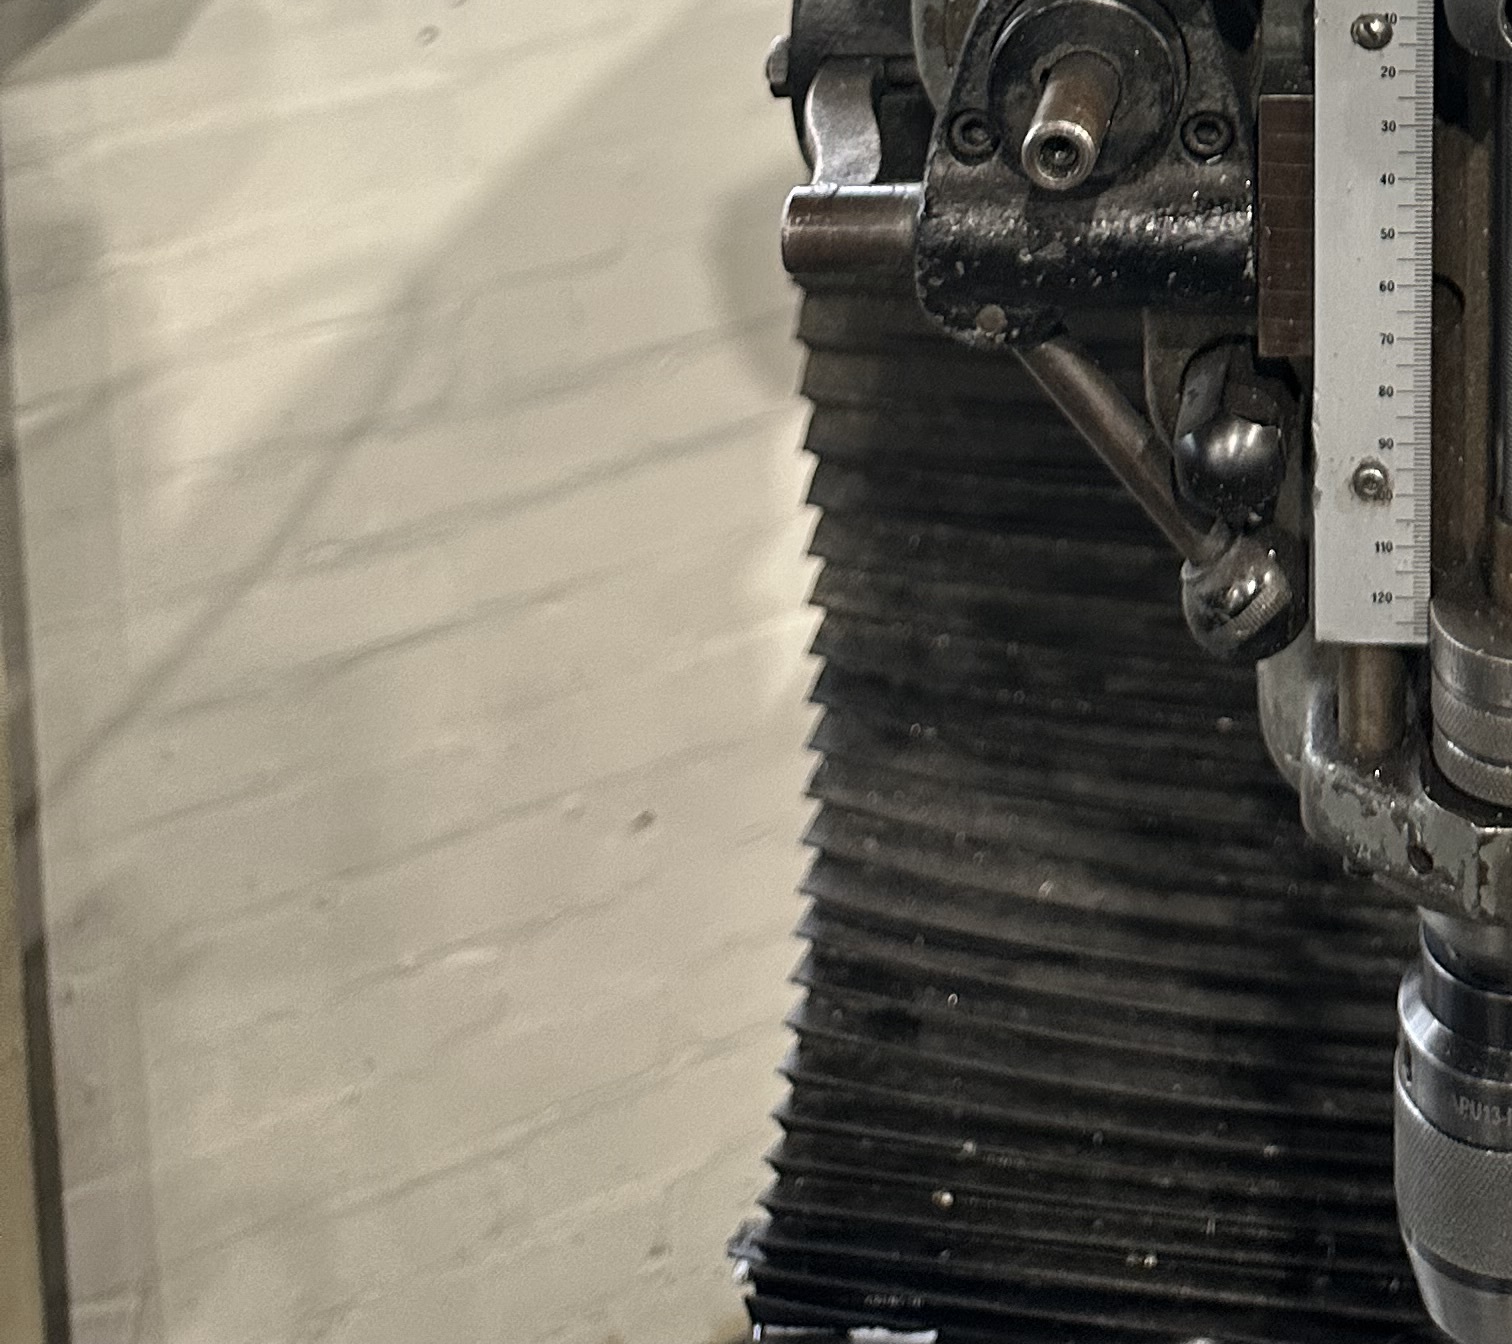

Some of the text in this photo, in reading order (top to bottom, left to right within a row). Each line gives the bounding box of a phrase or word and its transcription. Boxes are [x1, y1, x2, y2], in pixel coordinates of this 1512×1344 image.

[1380, 65, 1397, 78] 20
[1380, 121, 1397, 133] 30
[1379, 173, 1396, 185] 40
[1380, 227, 1396, 240] 50
[1379, 280, 1395, 293] 60
[1379, 333, 1395, 345] 70
[1378, 385, 1394, 397] 80
[1378, 437, 1394, 450] 90
[1374, 541, 1394, 553] 110
[1371, 592, 1393, 604] 120
